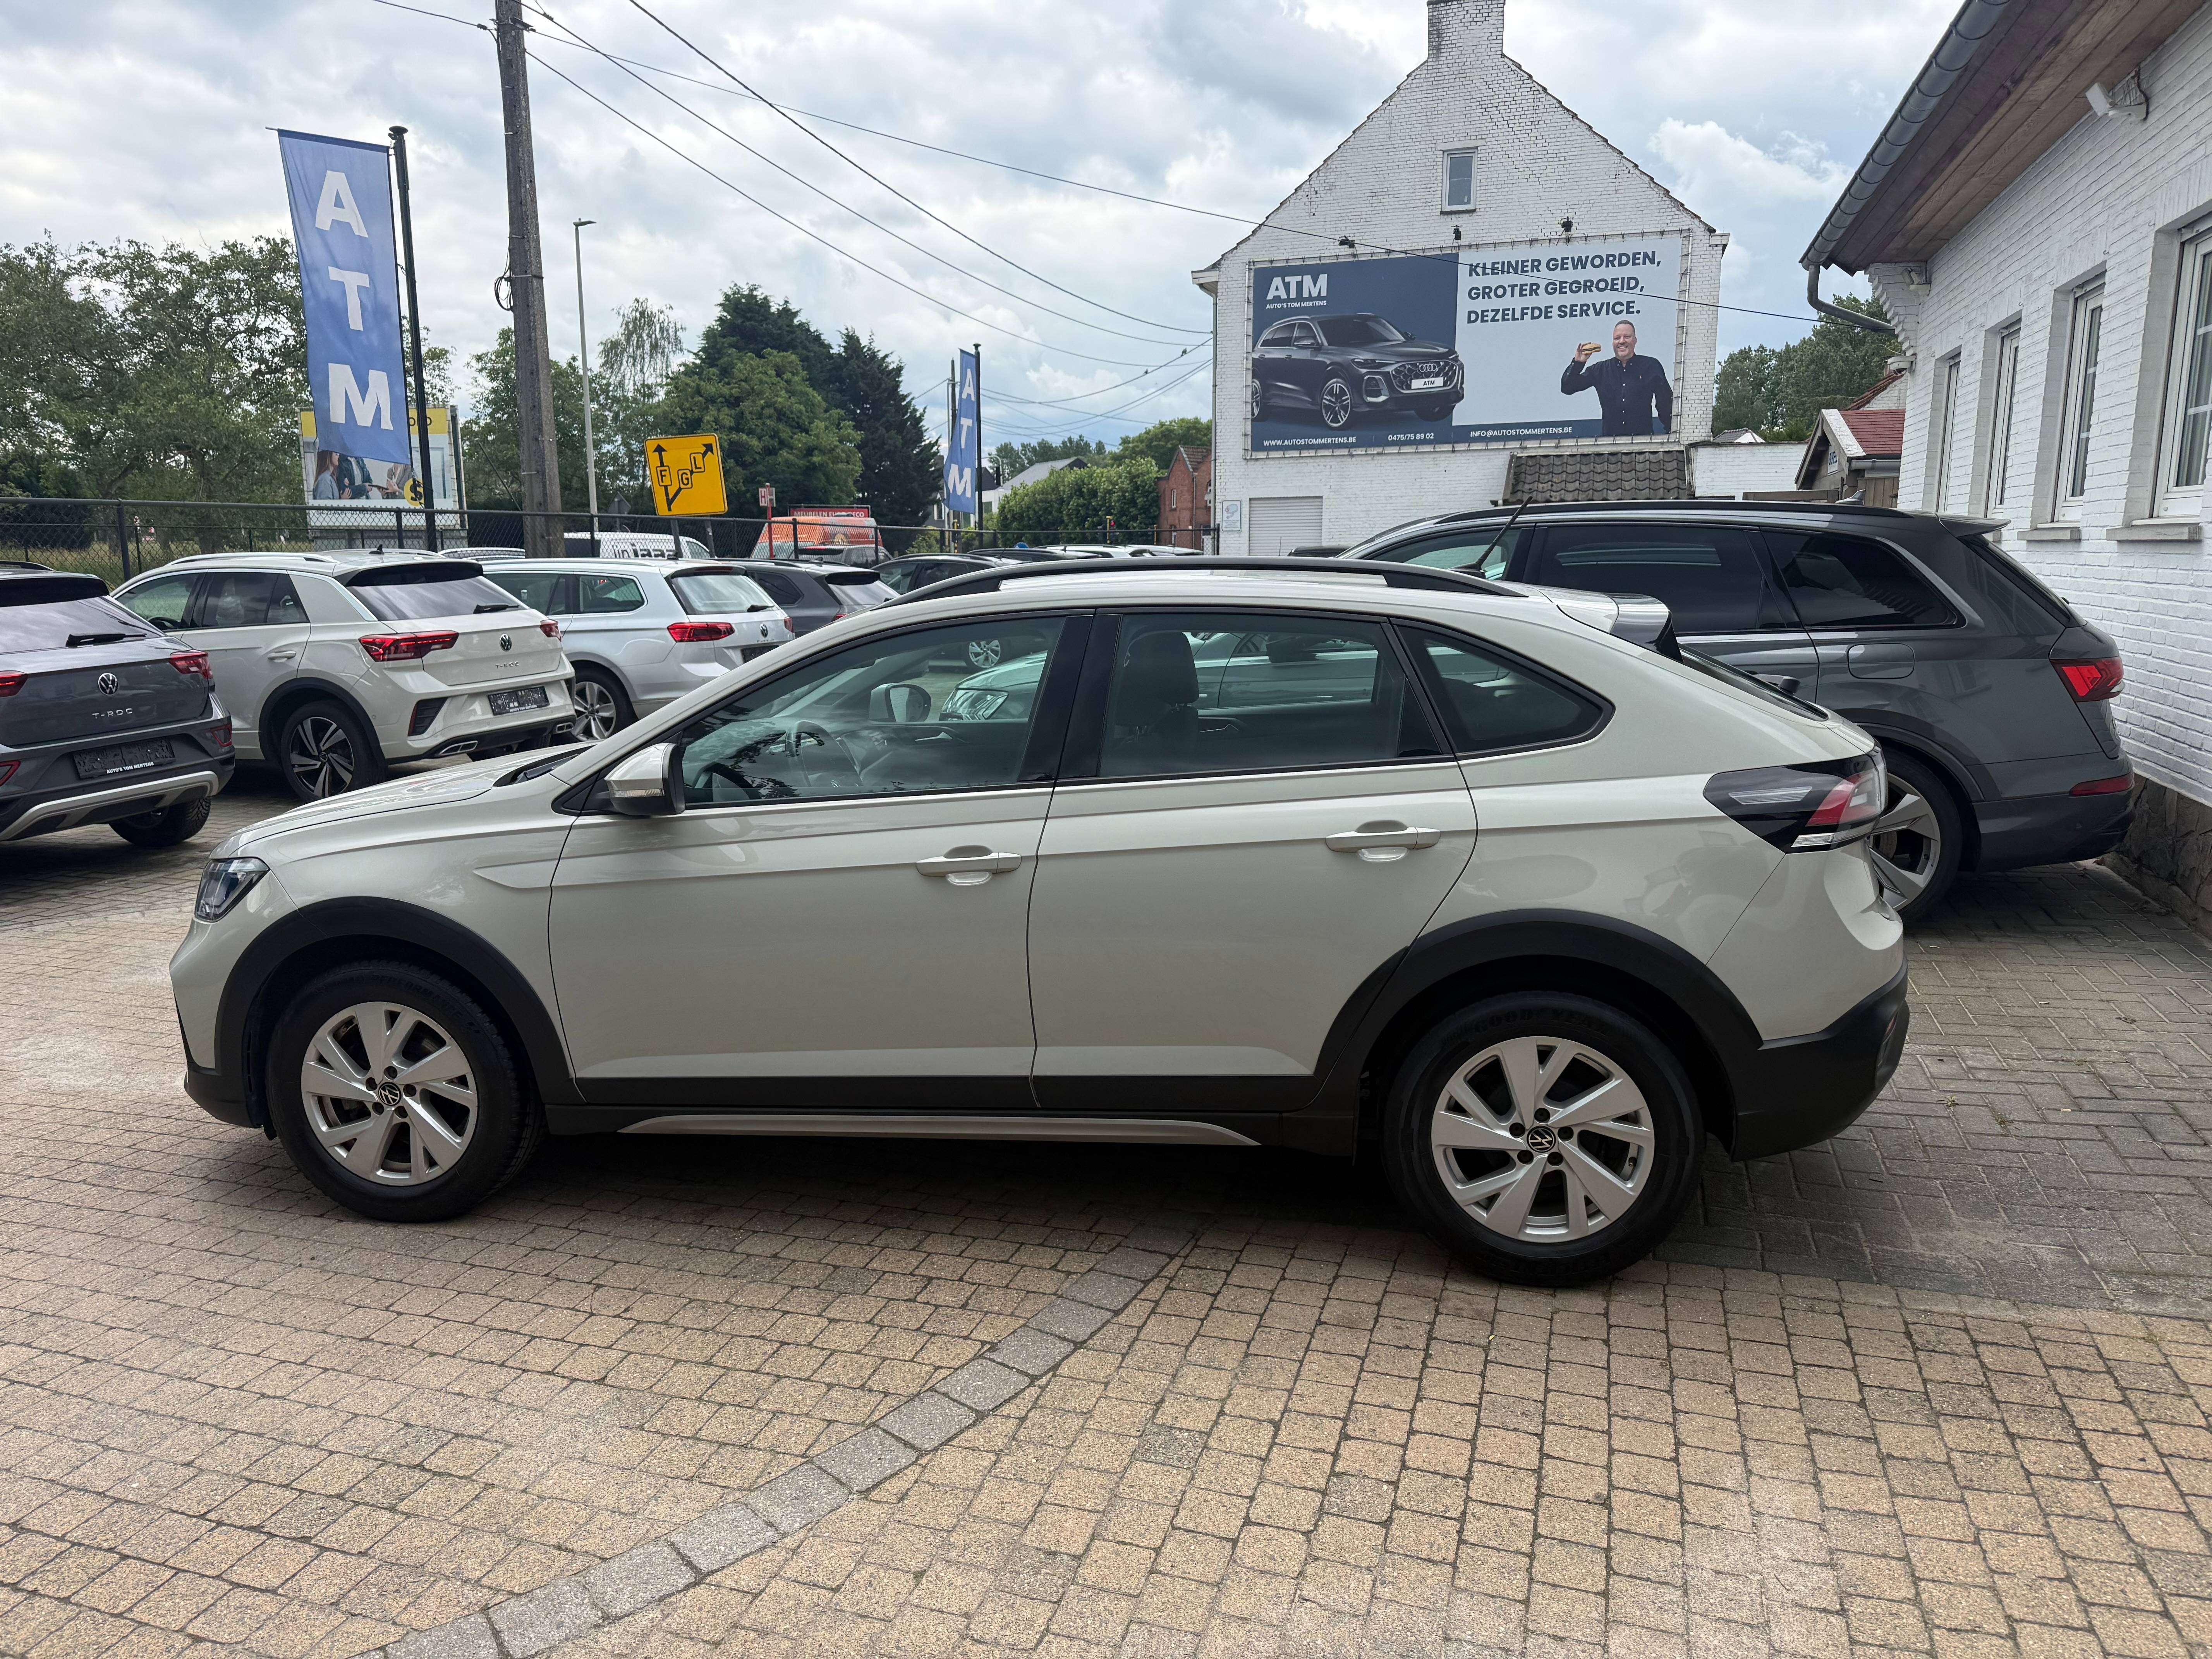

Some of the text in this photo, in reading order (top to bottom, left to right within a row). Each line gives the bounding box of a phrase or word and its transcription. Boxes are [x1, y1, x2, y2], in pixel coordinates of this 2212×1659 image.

[1469, 251, 1661, 277] KLEINER GEWORDEN,
[1266, 274, 1327, 300] ATM
[1468, 276, 1645, 301] GROTER GEGROEID,
[1467, 300, 1641, 324] DEZELFDE SERVICE.
[1470, 427, 1572, 437] INFO@AUTOSTOMMERTENS.BE
[1263, 436, 1356, 446] WWW.AUTOSTOMMERTENS.BE
[693, 456, 702, 469] L
[659, 469, 667, 483] F
[681, 472, 689, 486] G
[760, 490, 766, 504] H
[92, 708, 133, 719] T-ROC
